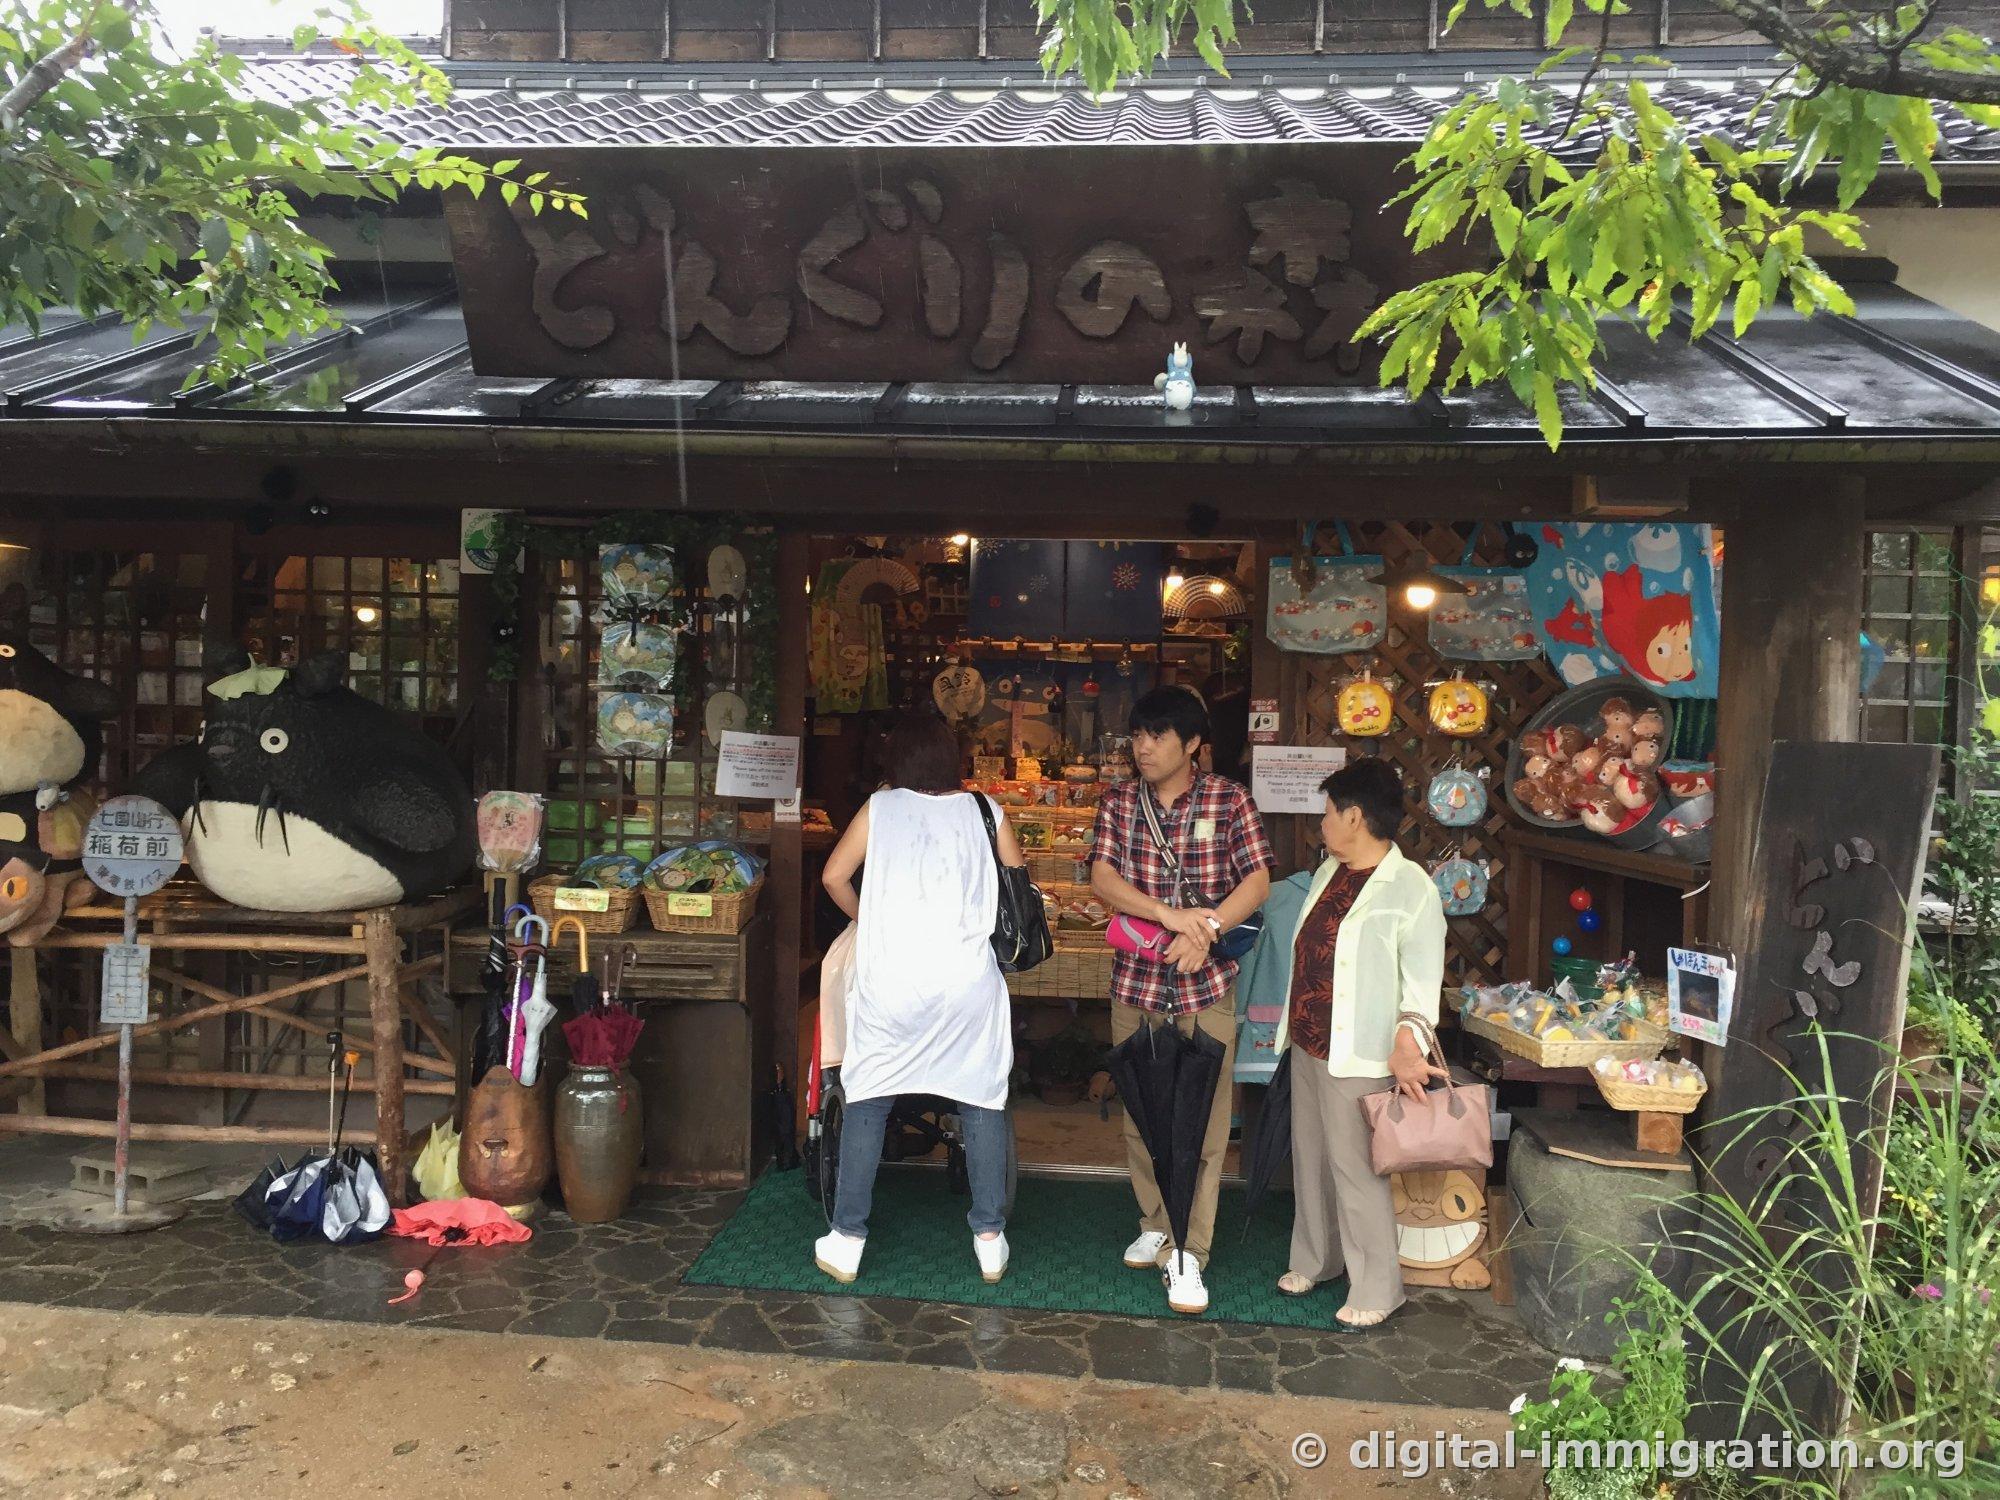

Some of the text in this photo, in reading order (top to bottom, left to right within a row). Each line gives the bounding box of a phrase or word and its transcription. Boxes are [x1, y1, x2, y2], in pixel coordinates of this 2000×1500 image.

[510, 178, 1378, 371] どんぐりの森
[88, 834, 169, 857] 稲荷前
